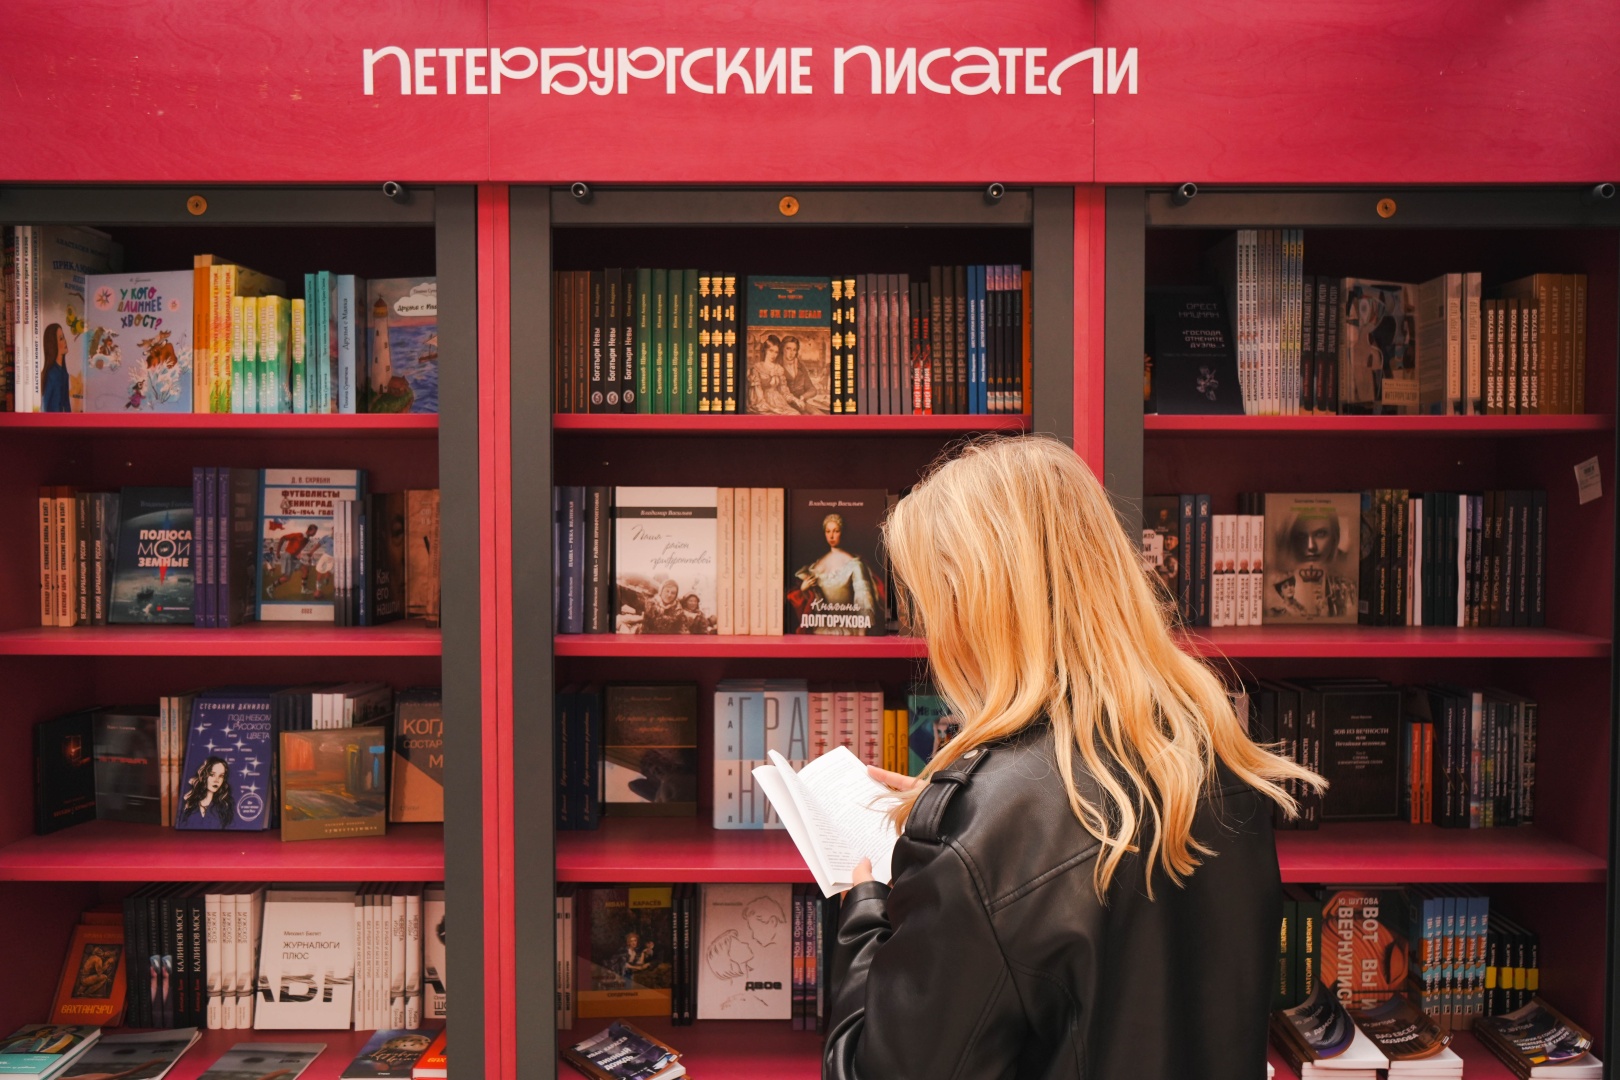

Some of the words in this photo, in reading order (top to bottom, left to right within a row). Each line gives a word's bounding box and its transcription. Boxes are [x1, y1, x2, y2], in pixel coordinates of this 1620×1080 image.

[362, 46, 813, 97] ПЕТЕРБУРГСКИЕ
[832, 46, 1140, 97] ПИСАТЕЛИ
[120, 288, 128, 300] У
[131, 286, 157, 300] КОГО
[117, 296, 162, 312] ДЛИННЕЕ
[120, 313, 162, 331] ХВОСТ?
[592, 328, 600, 346] Невы
[608, 328, 616, 346] Невы
[624, 326, 632, 346] Невы
[933, 296, 942, 382] ПЕРЕБЕЖЧИК
[945, 296, 954, 382] ПЕРЕБЕЖЧИК
[958, 296, 966, 382] ПЕРЕБЕЖЧИК
[592, 348, 602, 382] Богатыри
[607, 348, 617, 382] Богатыри
[624, 346, 634, 380] Богатыри
[1522, 343, 1530, 372] Андрей
[1496, 376, 1504, 408] АРМИЯ
[1530, 376, 1538, 408] АРМИЯ
[281, 490, 340, 498] ФУТБОЛИСТЫ
[280, 499, 334, 509] ЛЕНИНГРАД
[139, 529, 193, 541] ПОЛЮСА
[137, 539, 191, 559] МОИ
[138, 557, 189, 568] ЗЕМНЫЕ
[376, 568, 390, 585] Как
[810, 598, 861, 613] Княгиня
[800, 613, 872, 629] ДОЛГОРУКОВА
[200, 703, 236, 711] СТЕФАНИЯ
[238, 703, 271, 711] ДАНИЛОВ
[228, 713, 244, 722] ПОД
[245, 713, 271, 722] НЕБОМ
[246, 732, 271, 741] ЦВЕТА
[403, 739, 443, 749] СОСТАР
[1348, 897, 1379, 905] ШУТОВА
[176, 908, 184, 932] МОСТ
[193, 908, 202, 932] МОСТ
[1362, 906, 1379, 943] ВОТ
[176, 932, 184, 972] КАЛИНОВ
[193, 932, 202, 972] КАЛИНОВ
[283, 941, 340, 949] ЖУРНАЛЮГИ
[282, 952, 309, 960] ПЛЮС
[1304, 957, 1312, 995] АНАТОЛИЙ
[1361, 959, 1378, 987] ВЫ
